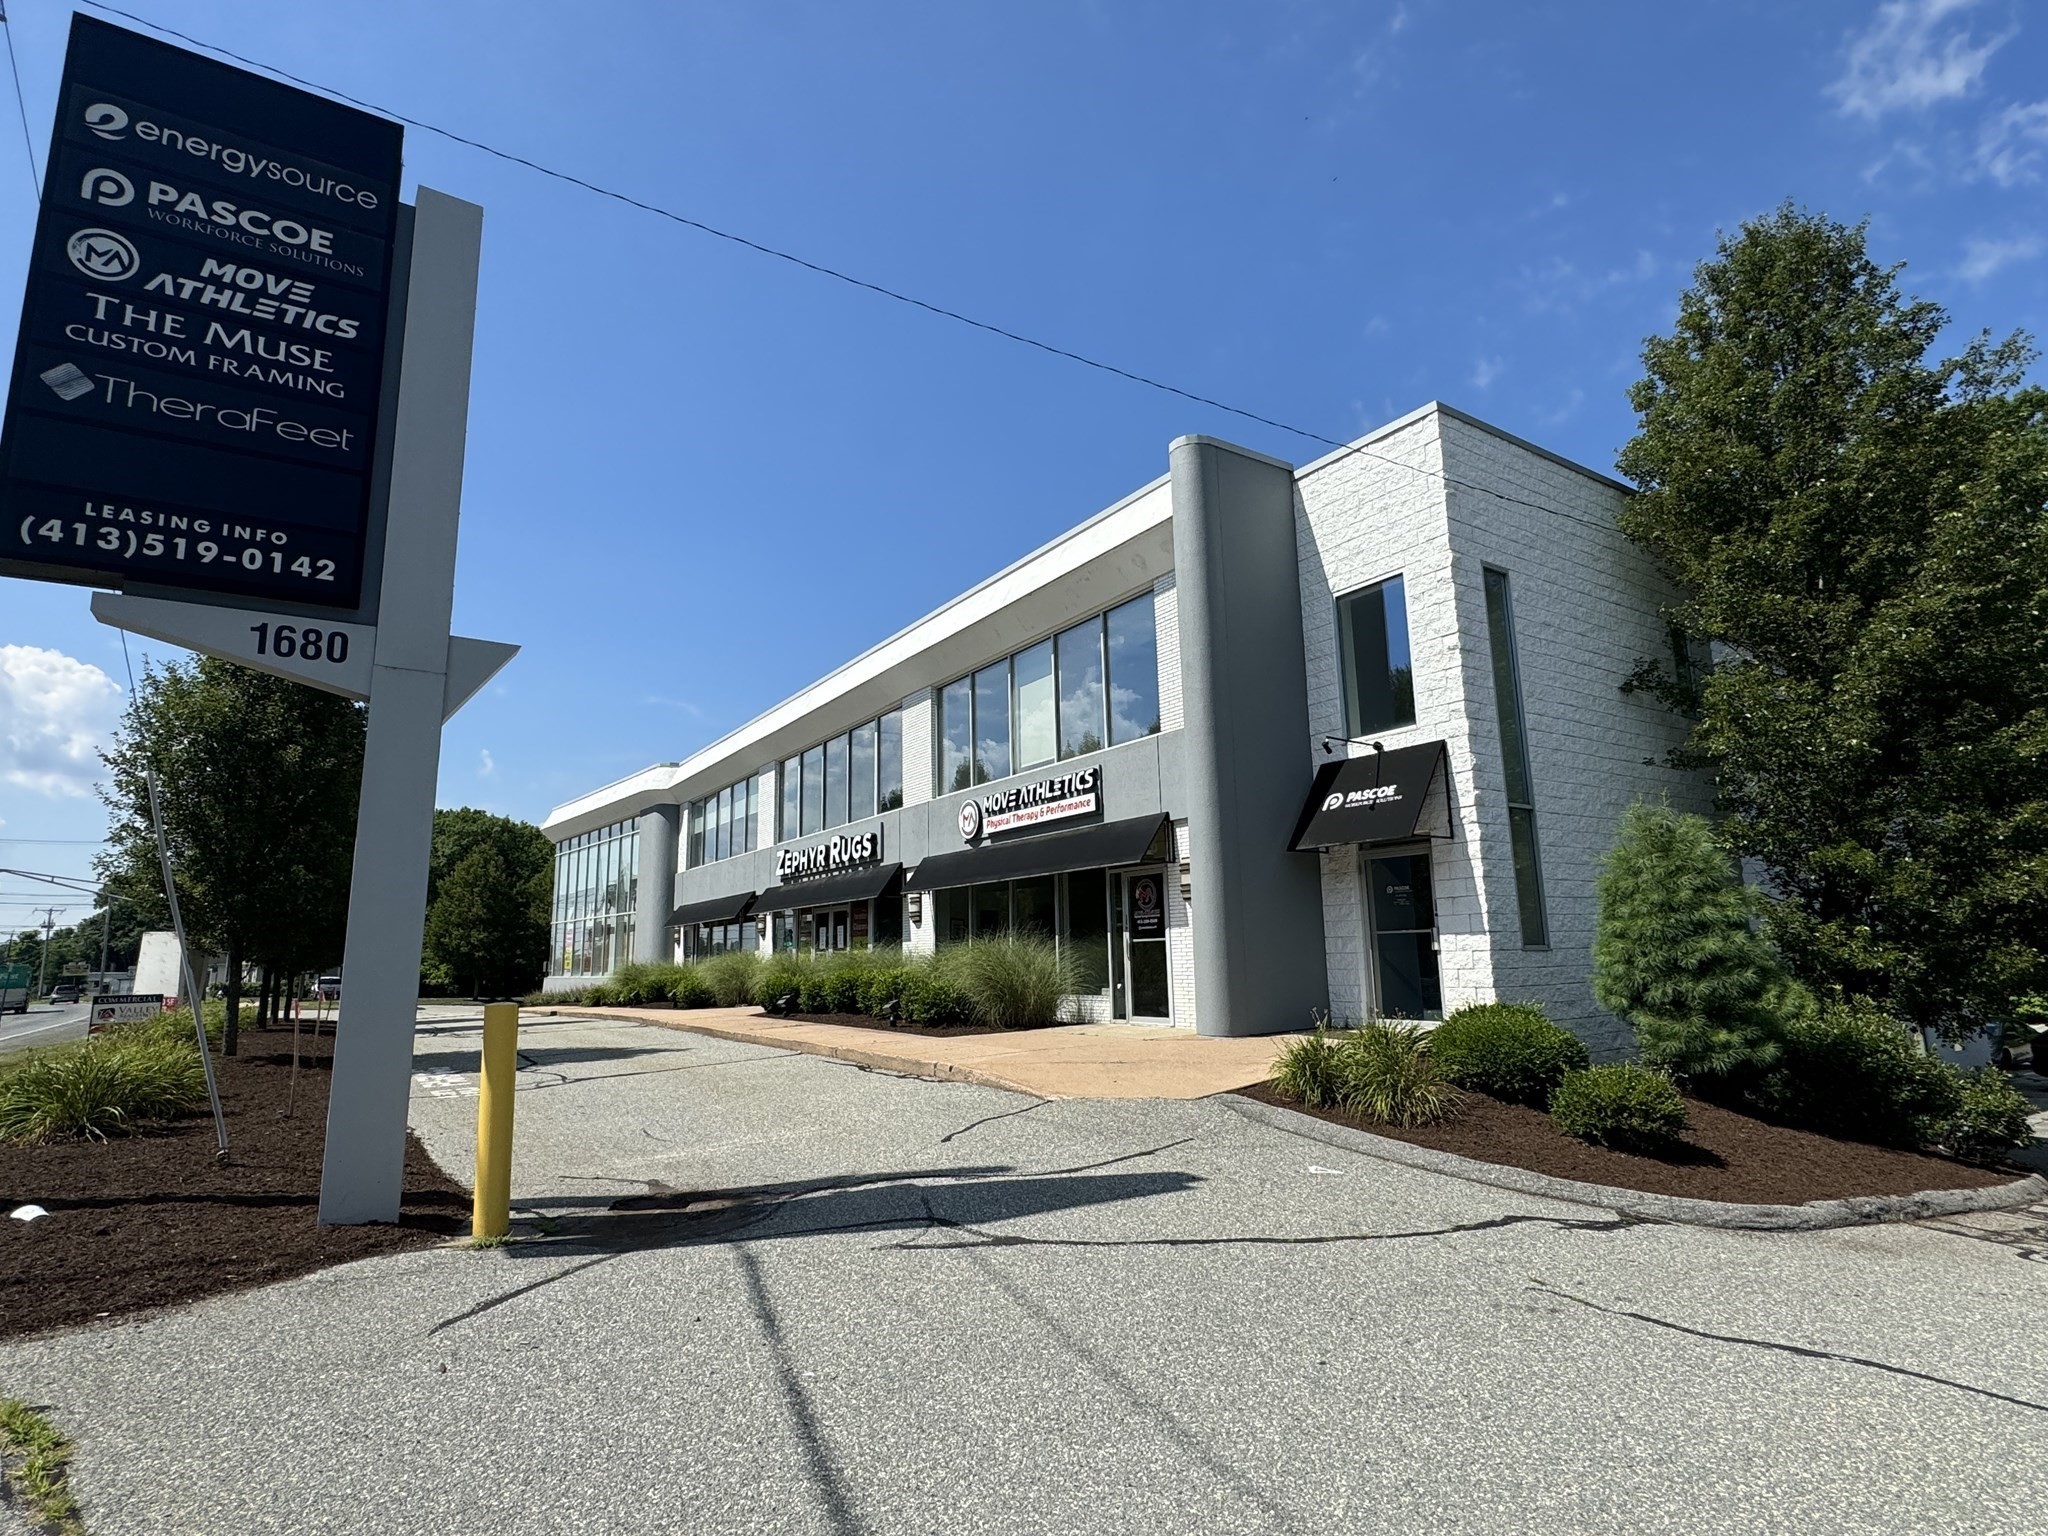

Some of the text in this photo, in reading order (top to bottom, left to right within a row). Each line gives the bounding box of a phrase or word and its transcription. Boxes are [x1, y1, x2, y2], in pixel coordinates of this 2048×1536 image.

[135, 120, 379, 210] energysource
[149, 181, 334, 255] PASCOE
[148, 207, 365, 277] WORKFORCE SOLUTIONS
[200, 258, 316, 304] MOVE
[144, 273, 361, 339] ATHLETICS
[86, 292, 335, 373] THE MUSE
[65, 324, 345, 399] CUSTOM FRAMING
[94, 373, 355, 451] TheraFeet
[85, 502, 289, 545] LEASING INFO
[20, 515, 337, 581] (413)519-0142
[250, 622, 349, 664] 1680
[983, 768, 1094, 813] MOVE ATHLETICS
[1346, 784, 1398, 803] PASCOE
[986, 816, 1011, 830] Physical
[1012, 810, 1039, 824] Therapy
[1046, 798, 1092, 816] Performance
[775, 832, 872, 876] ZEPHYR RUGS
[98, 996, 157, 1004] COMMERCIAL
[119, 1006, 158, 1014] VALLEY
